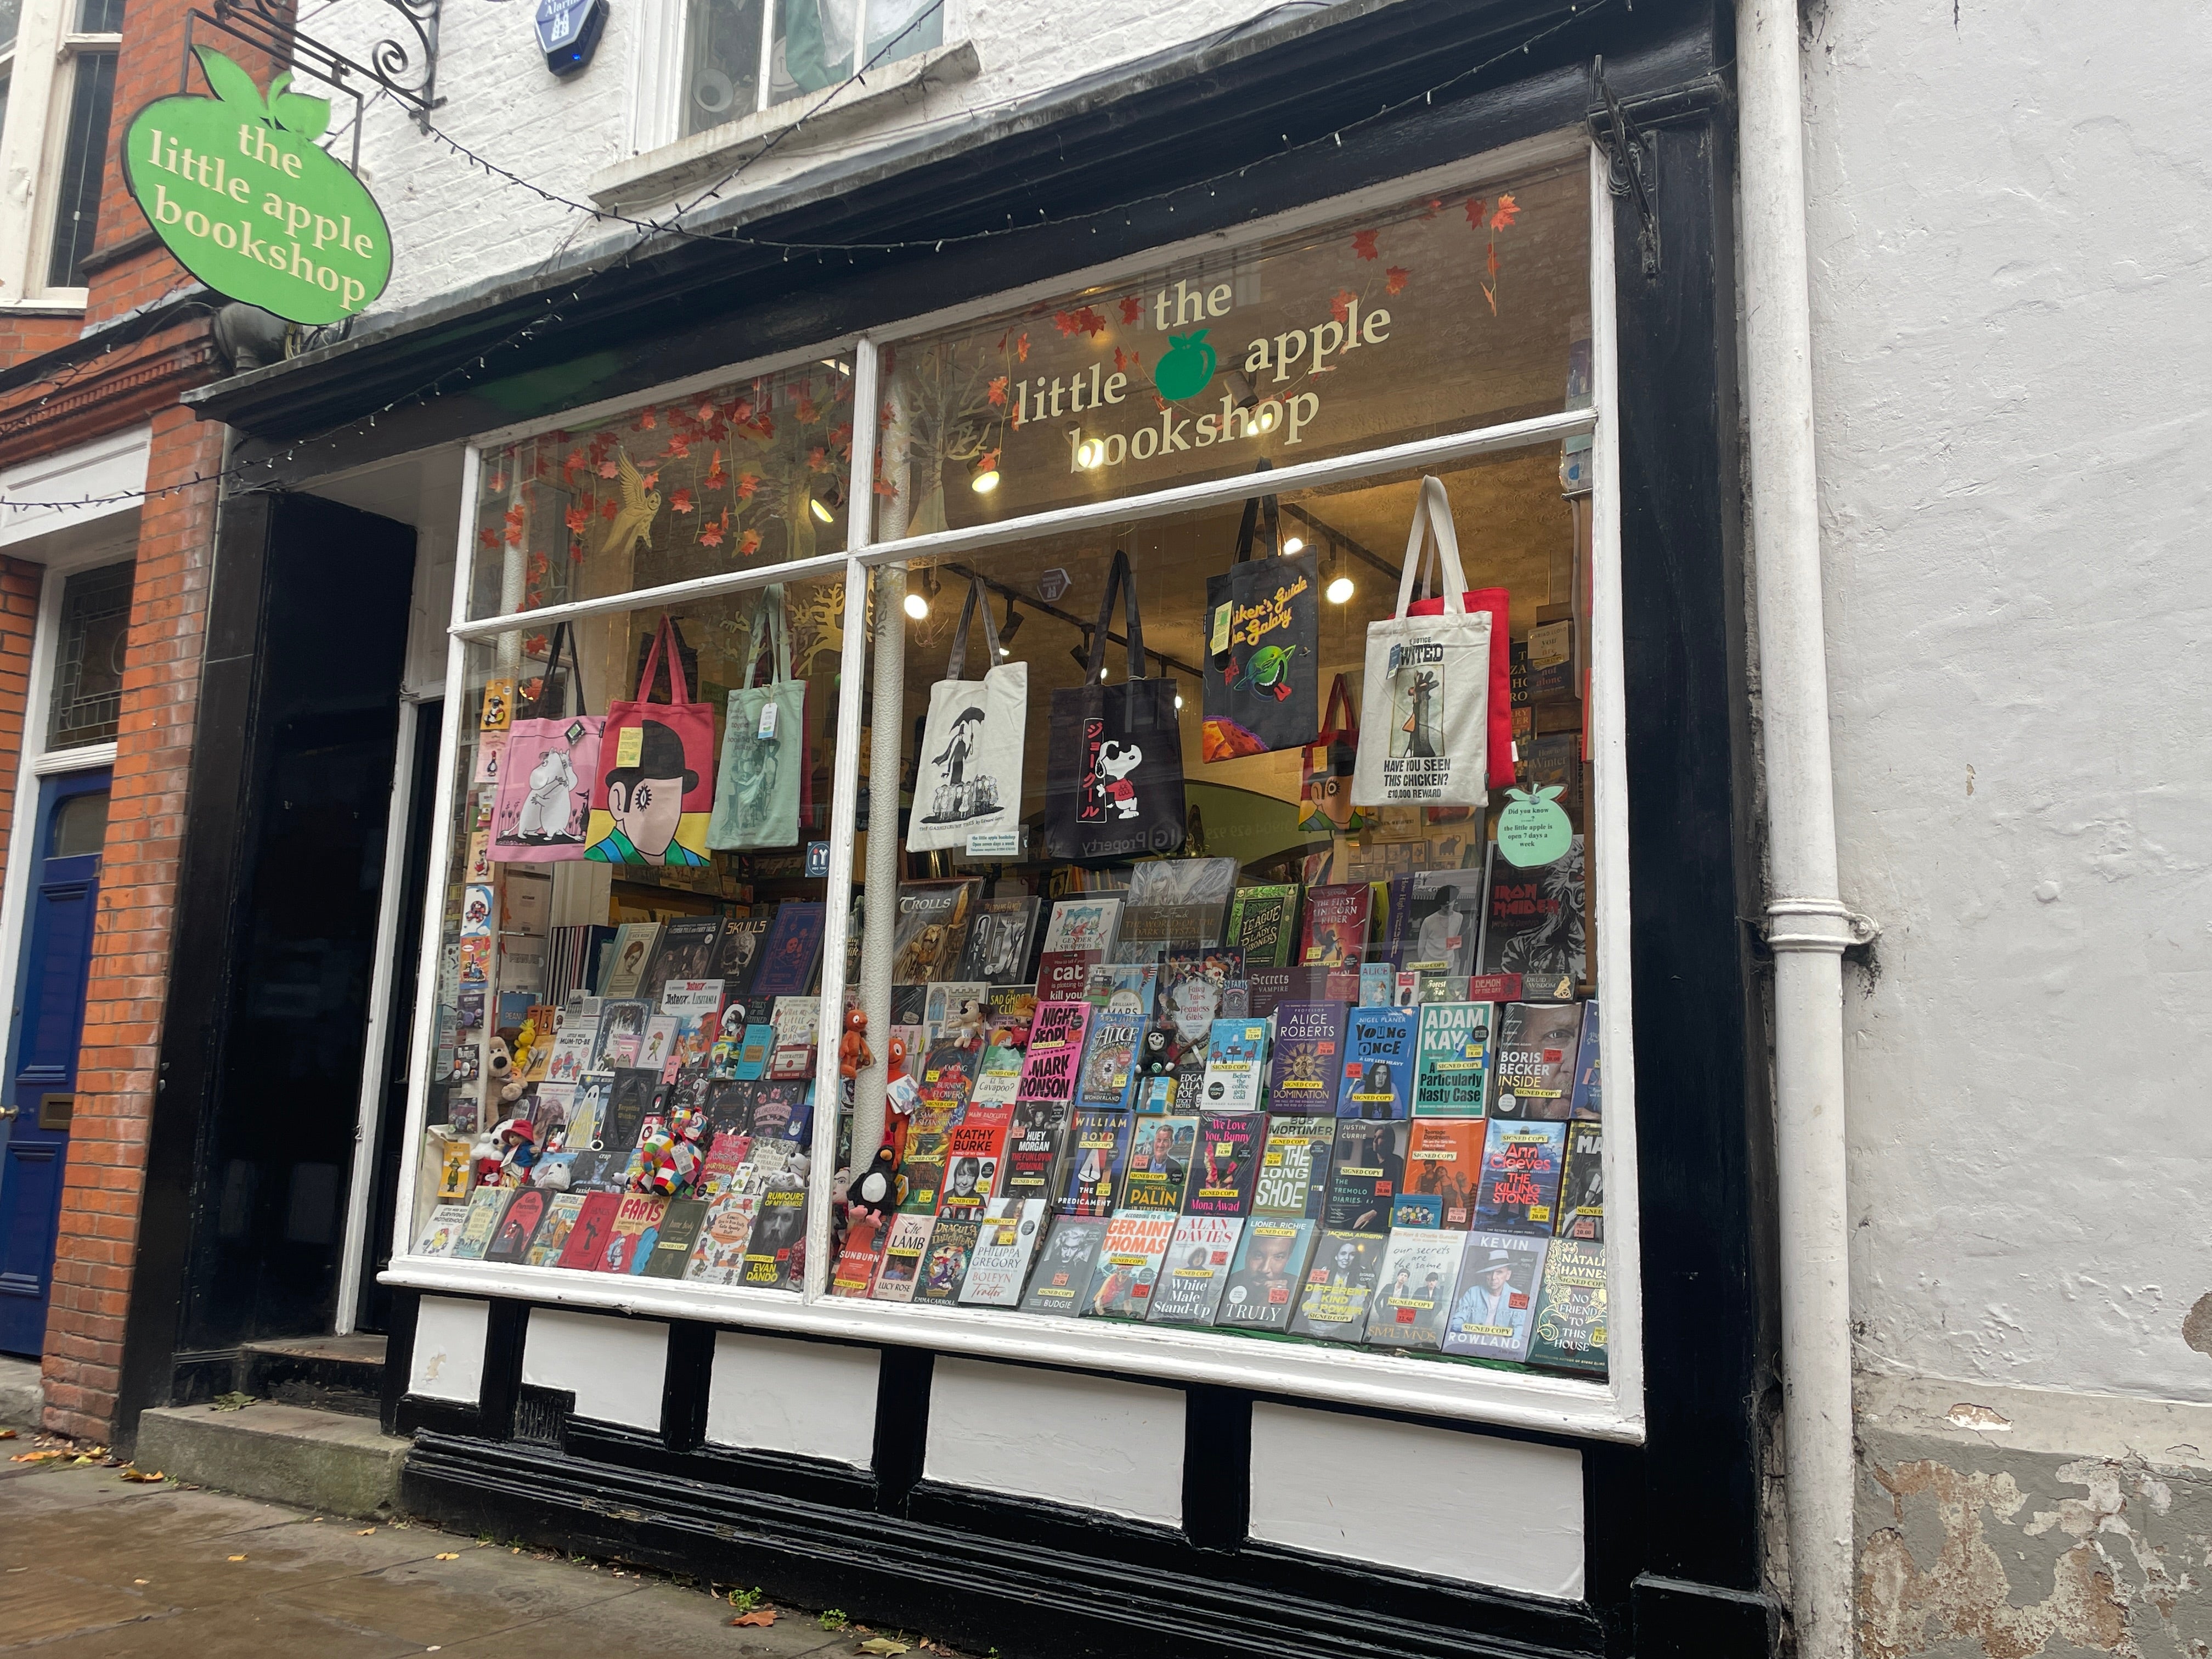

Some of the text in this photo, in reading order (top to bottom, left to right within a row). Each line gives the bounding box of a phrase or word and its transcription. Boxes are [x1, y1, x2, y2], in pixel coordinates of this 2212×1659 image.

[238, 123, 303, 179] the
[148, 128, 374, 259] little apple
[154, 184, 366, 312] bookshop
[1154, 279, 1232, 331] the
[1015, 298, 1391, 426] little apple
[1070, 389, 1320, 474] bookshop
[1274, 575, 1307, 613] Guide
[1246, 607, 1293, 646] Galaxy
[1384, 759, 1451, 772] HAVE YOU SEEN
[1532, 757, 1567, 768] Winter
[1082, 721, 1103, 819] ジョークール
[1384, 774, 1448, 786] THIS CHICKEN?
[1387, 789, 1441, 799] £10,000 REWARD
[813, 848, 828, 866] iY
[1494, 884, 1538, 901] IRON
[899, 896, 952, 914] TROLLS
[1242, 905, 1282, 936] LEAGUE
[1321, 915, 1347, 924] RIDER
[725, 921, 767, 934] SKULLS
[1053, 964, 1084, 981] cat
[686, 982, 707, 991] Asterix
[1224, 980, 1248, 990] 52 FARTS
[665, 994, 689, 1005] Asterix
[1290, 1014, 1328, 1025] ALICE
[1425, 1008, 1484, 1029] ADAM
[1280, 1026, 1335, 1037] ROBERTS
[1356, 1024, 1406, 1041] YOUNG
[1500, 1051, 1541, 1063] BORIS
[1029, 1054, 1070, 1077] MARK
[1420, 1074, 1482, 1088] Particularly
[1177, 1090, 1193, 1098] POE
[1075, 1118, 1127, 1127] WILLIAM
[1212, 1119, 1247, 1130] We Love
[955, 1130, 995, 1139] KATHY
[1026, 1131, 1046, 1141] HUEY
[1284, 1145, 1311, 1166] THE
[1506, 1143, 1538, 1159] Ann
[767, 1192, 805, 1201] RUMOURS
[1130, 1189, 1177, 1206] PALIN
[620, 1199, 664, 1222] FARTS
[1191, 1199, 1240, 1212] Mona Awad
[1250, 1221, 1278, 1229] LIONEL
[891, 1235, 926, 1249] LAMB
[932, 1235, 975, 1249] DAUGHTERS
[1480, 1237, 1529, 1251] KEVIN
[839, 1250, 880, 1262] SUNBURN
[978, 1247, 1020, 1257] PHILIPPA
[1417, 1245, 1450, 1255] secrets
[753, 1263, 776, 1273] EVAN
[746, 1272, 778, 1282] DANDO
[878, 1282, 911, 1292] LUCY ROSE
[1171, 1278, 1207, 1291] White
[1305, 1284, 1372, 1296] DIFFERENT
[1043, 1300, 1072, 1309] BUDGIE
[1572, 1294, 1589, 1303] NO
[1226, 1304, 1281, 1322] TRULY
[1562, 1328, 1587, 1339] THIS
[1448, 1333, 1521, 1349] ROWLAND
